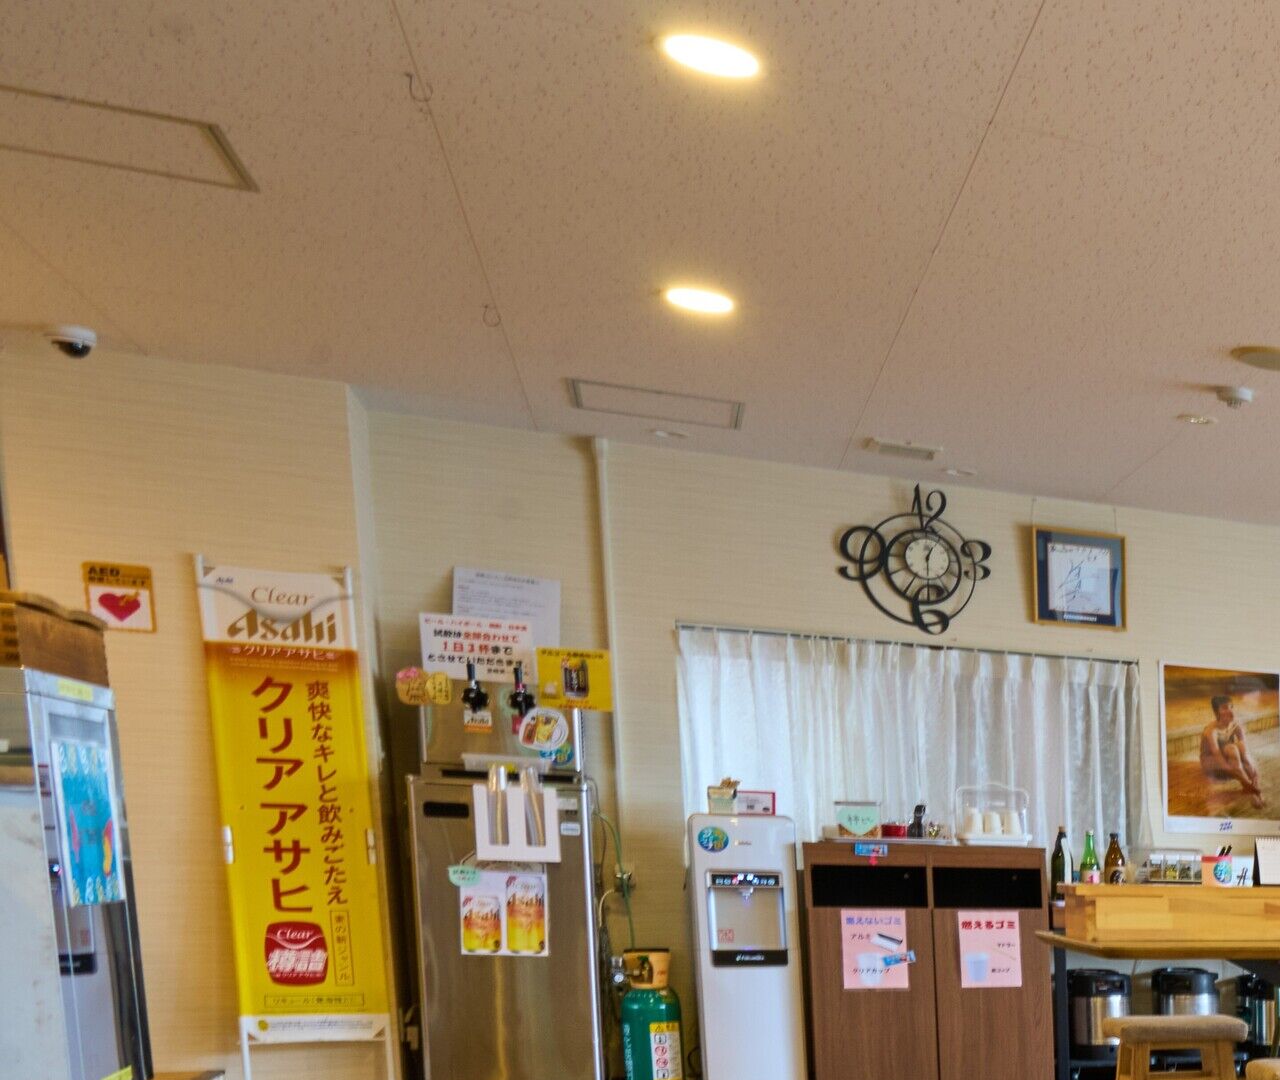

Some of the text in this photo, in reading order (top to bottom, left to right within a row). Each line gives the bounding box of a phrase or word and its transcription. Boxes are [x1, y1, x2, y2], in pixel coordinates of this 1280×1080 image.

[911, 483, 947, 530] 12
[88, 566, 120, 577] AED
[838, 525, 887, 581] 9
[961, 539, 992, 580] 3
[251, 585, 315, 606] Clear
[911, 584, 950, 635] 6
[227, 608, 337, 644] Asahi
[304, 680, 348, 906] 爽快なキレと飲みごたえ
[961, 919, 1015, 930] 燃えるゴミ
